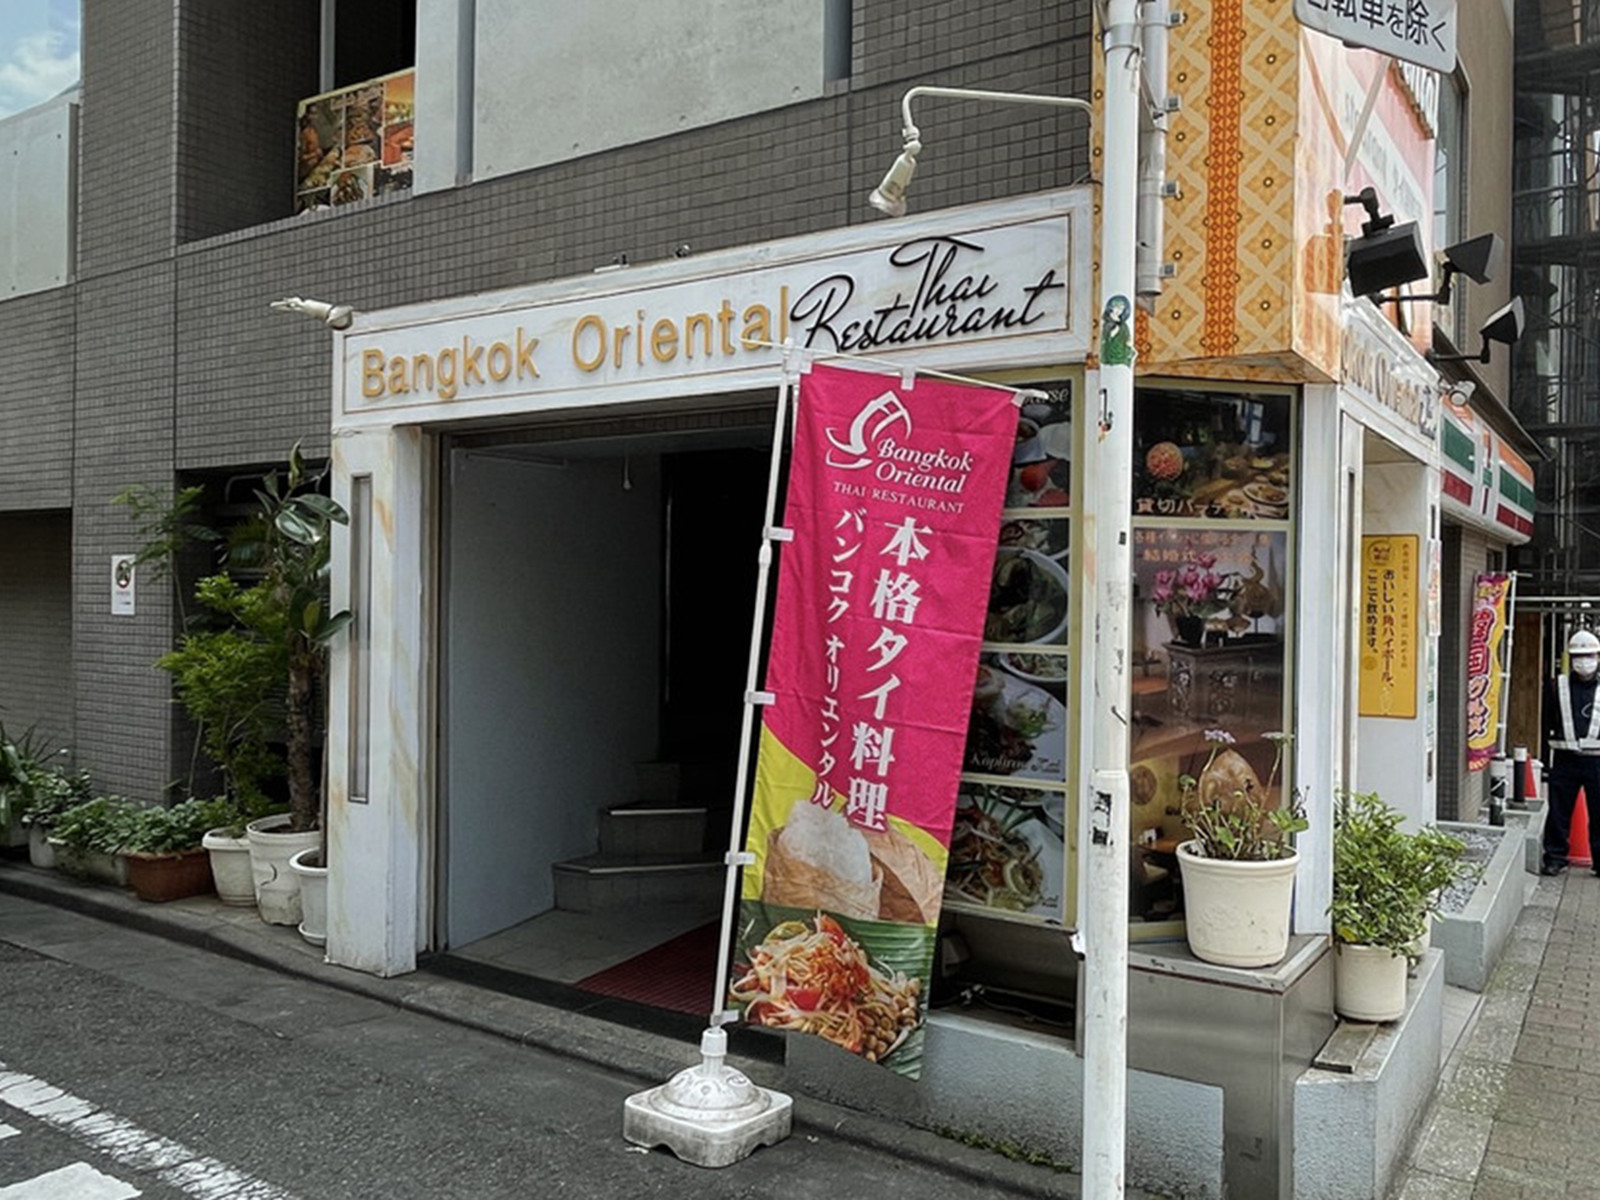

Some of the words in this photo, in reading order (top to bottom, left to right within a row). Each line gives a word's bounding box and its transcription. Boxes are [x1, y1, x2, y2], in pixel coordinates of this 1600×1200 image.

[1307, 0, 1447, 52] 転車を除く
[789, 271, 1066, 353] Restaurant
[890, 236, 998, 318] Thai
[361, 328, 540, 400] Bangkok
[571, 286, 789, 373] Oriental
[875, 461, 966, 494] Oriental
[876, 438, 974, 473] Bangkok
[833, 481, 866, 497] THAI
[872, 489, 966, 514] RESTAURANT
[826, 507, 868, 624] バンコク
[845, 516, 934, 832] 本格タイ料理
[813, 634, 846, 808] オリエンタル
